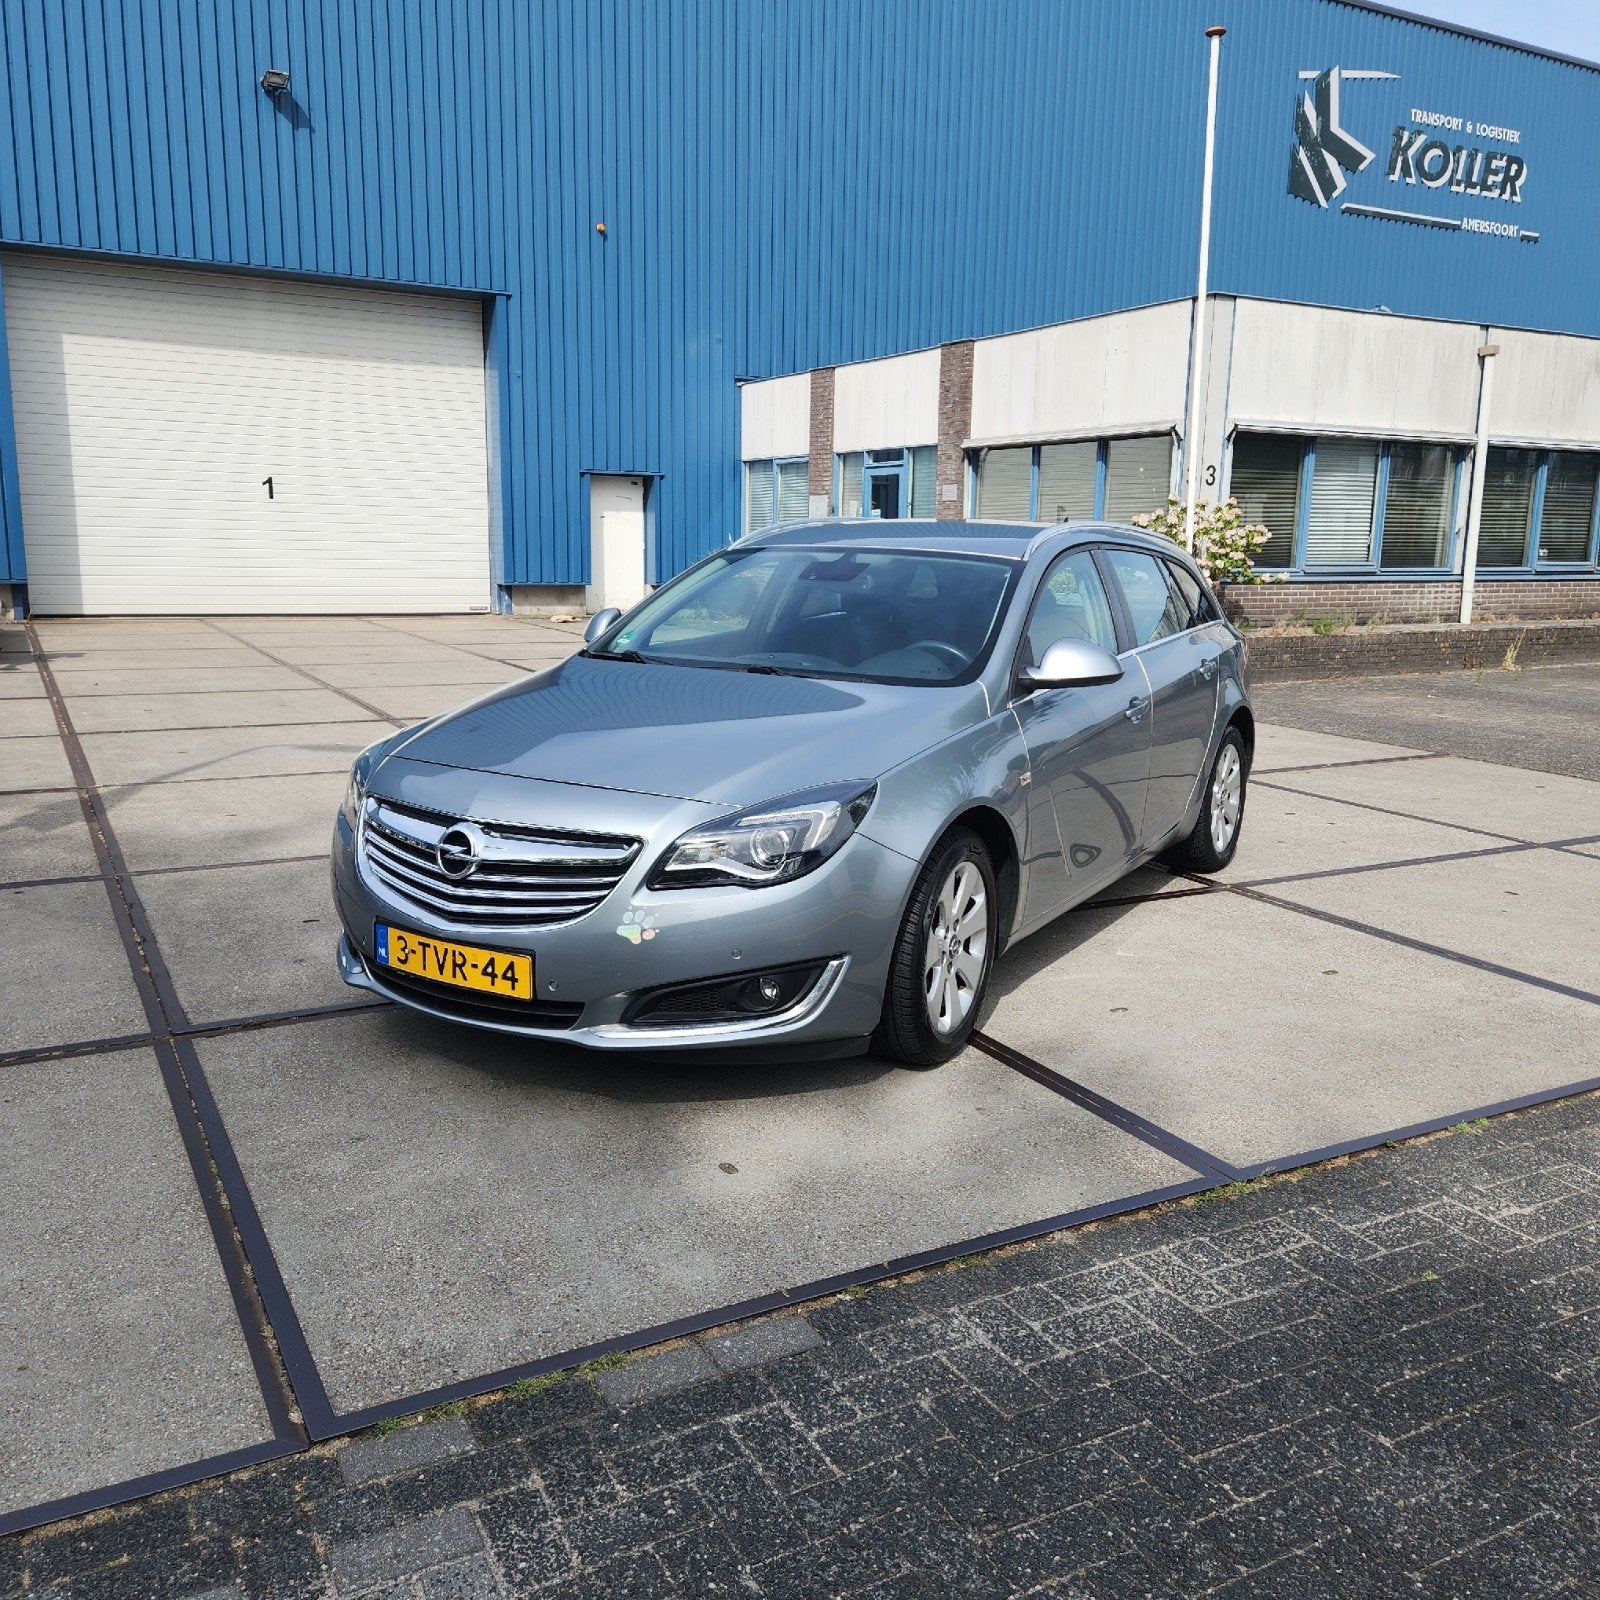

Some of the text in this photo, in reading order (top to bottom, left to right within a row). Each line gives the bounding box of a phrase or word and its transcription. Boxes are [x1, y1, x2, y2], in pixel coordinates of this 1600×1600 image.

[1410, 108, 1521, 144] TRANSPORT & LOGISTIEK
[1386, 125, 1528, 204] KOLLER
[1461, 217, 1519, 238] AMERSFOORT
[1205, 464, 1217, 486] 3
[261, 476, 274, 500] 1
[377, 946, 388, 959] NL
[396, 935, 519, 991] 3-TVR-44
